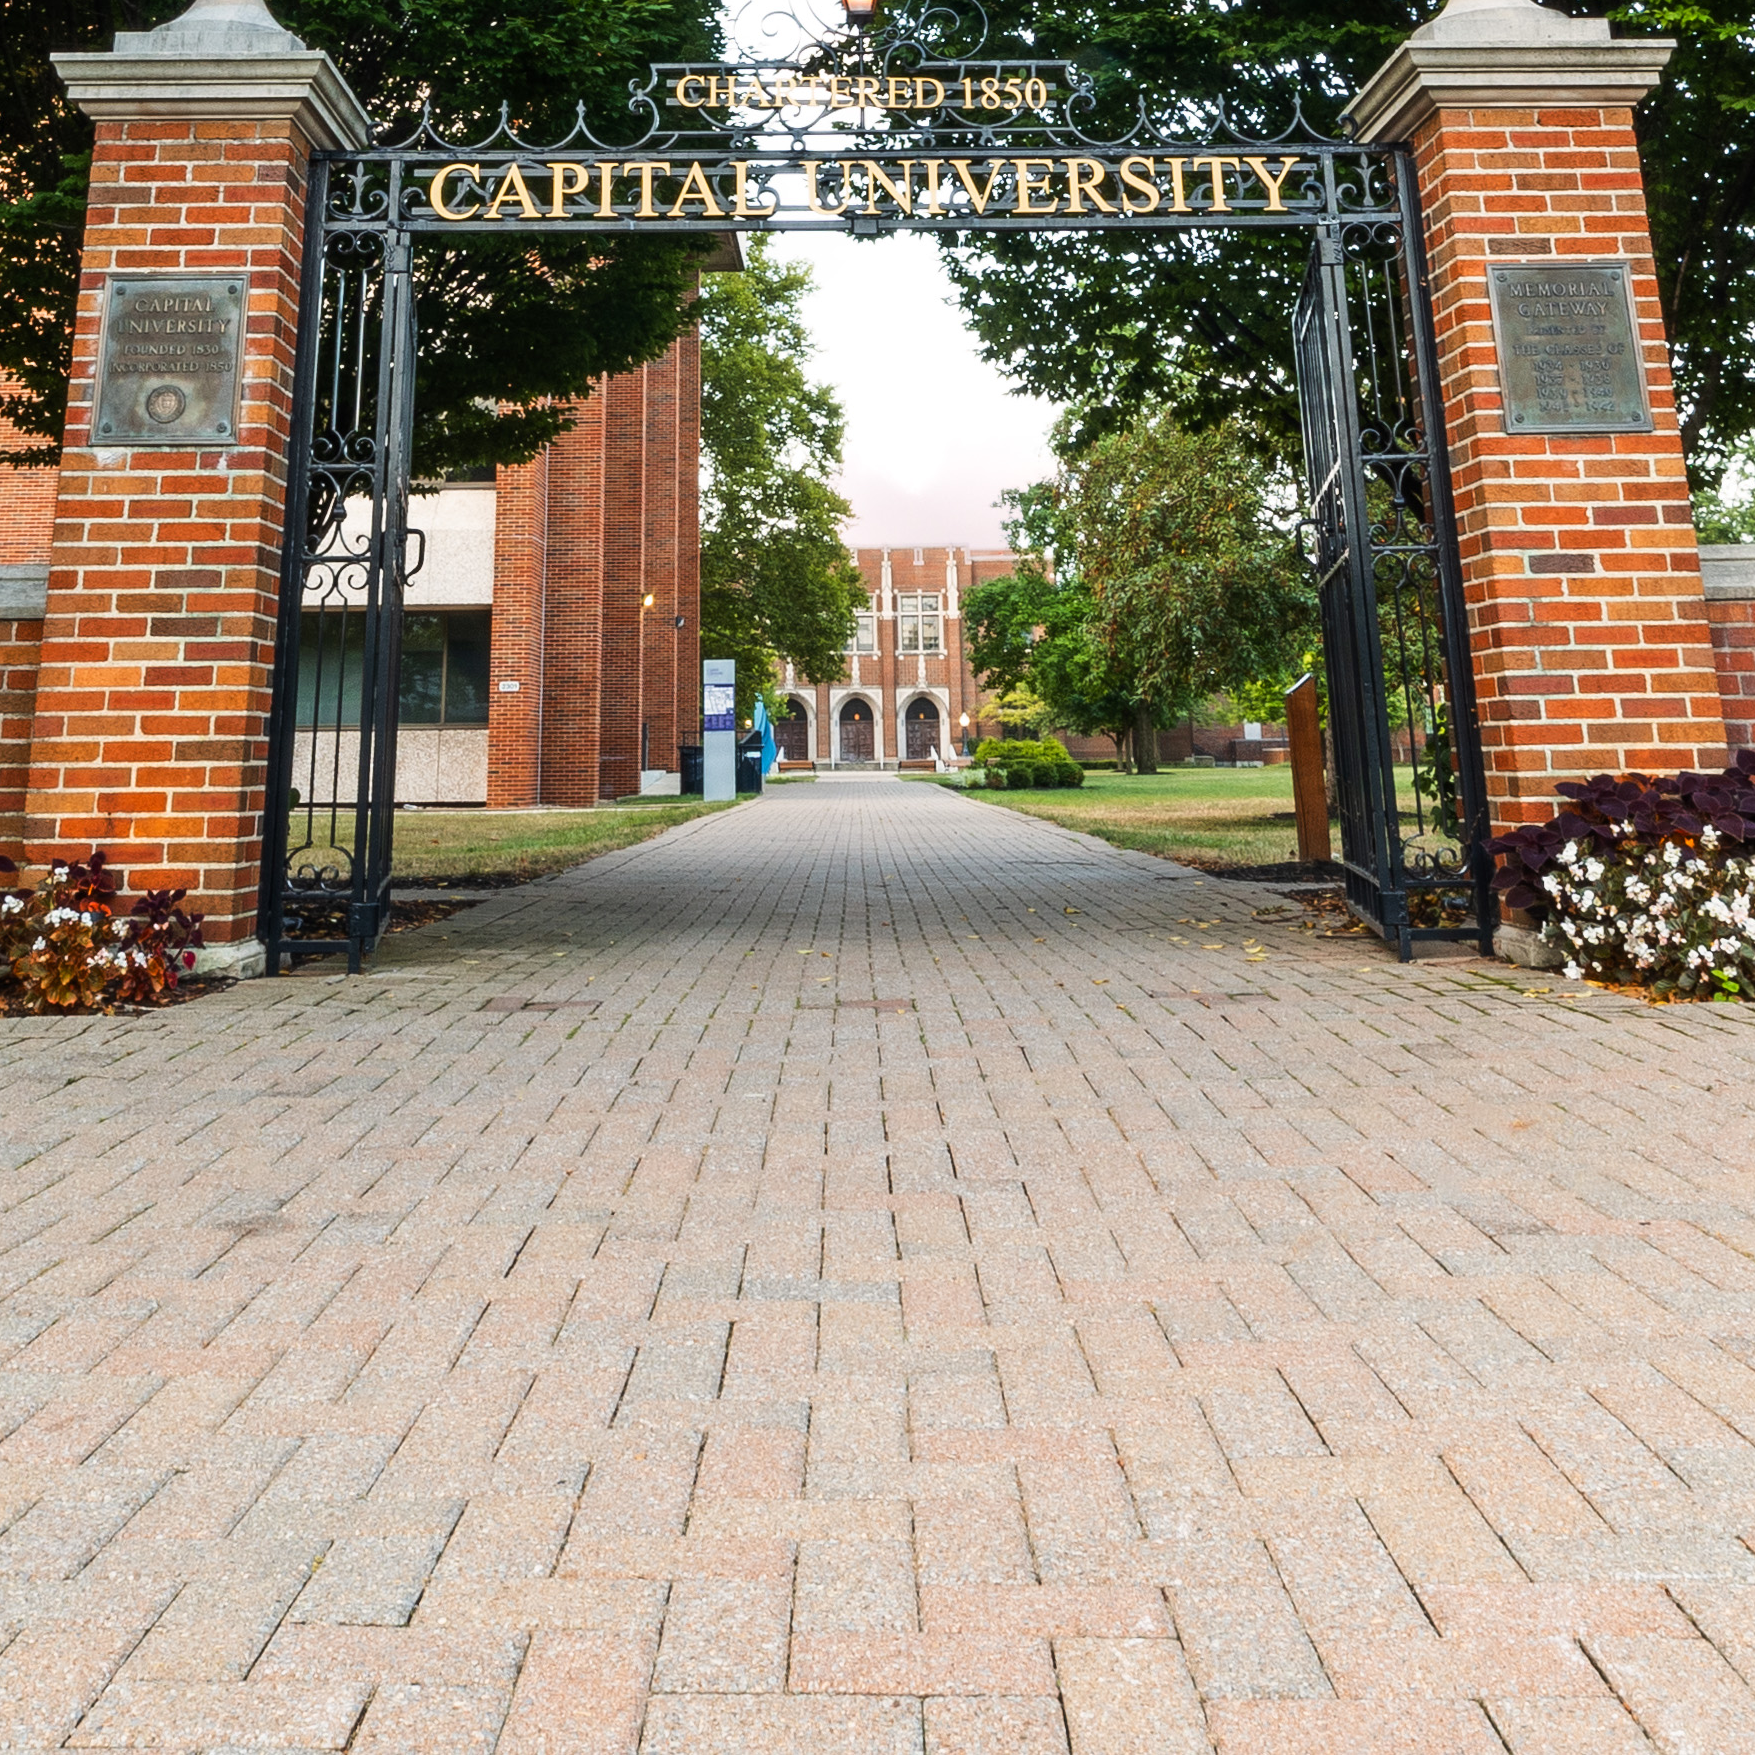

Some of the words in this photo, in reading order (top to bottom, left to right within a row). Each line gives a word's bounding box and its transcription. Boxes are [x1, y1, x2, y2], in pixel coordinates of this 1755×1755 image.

[675, 74, 945, 109] CHARTERED
[960, 76, 1048, 111] 1850
[428, 160, 777, 221] CAPITAL
[798, 156, 1301, 216] UNIVERSITY
[1510, 282, 1615, 298] MEMORIAL
[135, 296, 216, 313] CAPITAL
[1517, 301, 1608, 318] GATEWAY
[117, 318, 232, 335] UNIVERSITY
[124, 344, 187, 356] FOUNDED
[191, 344, 220, 356] 1830
[1512, 344, 1541, 357] THE
[1544, 343, 1603, 357] CLASSES
[1607, 342, 1626, 356] OF
[108, 361, 200, 374] INCORPORATED
[205, 361, 233, 374] 1850
